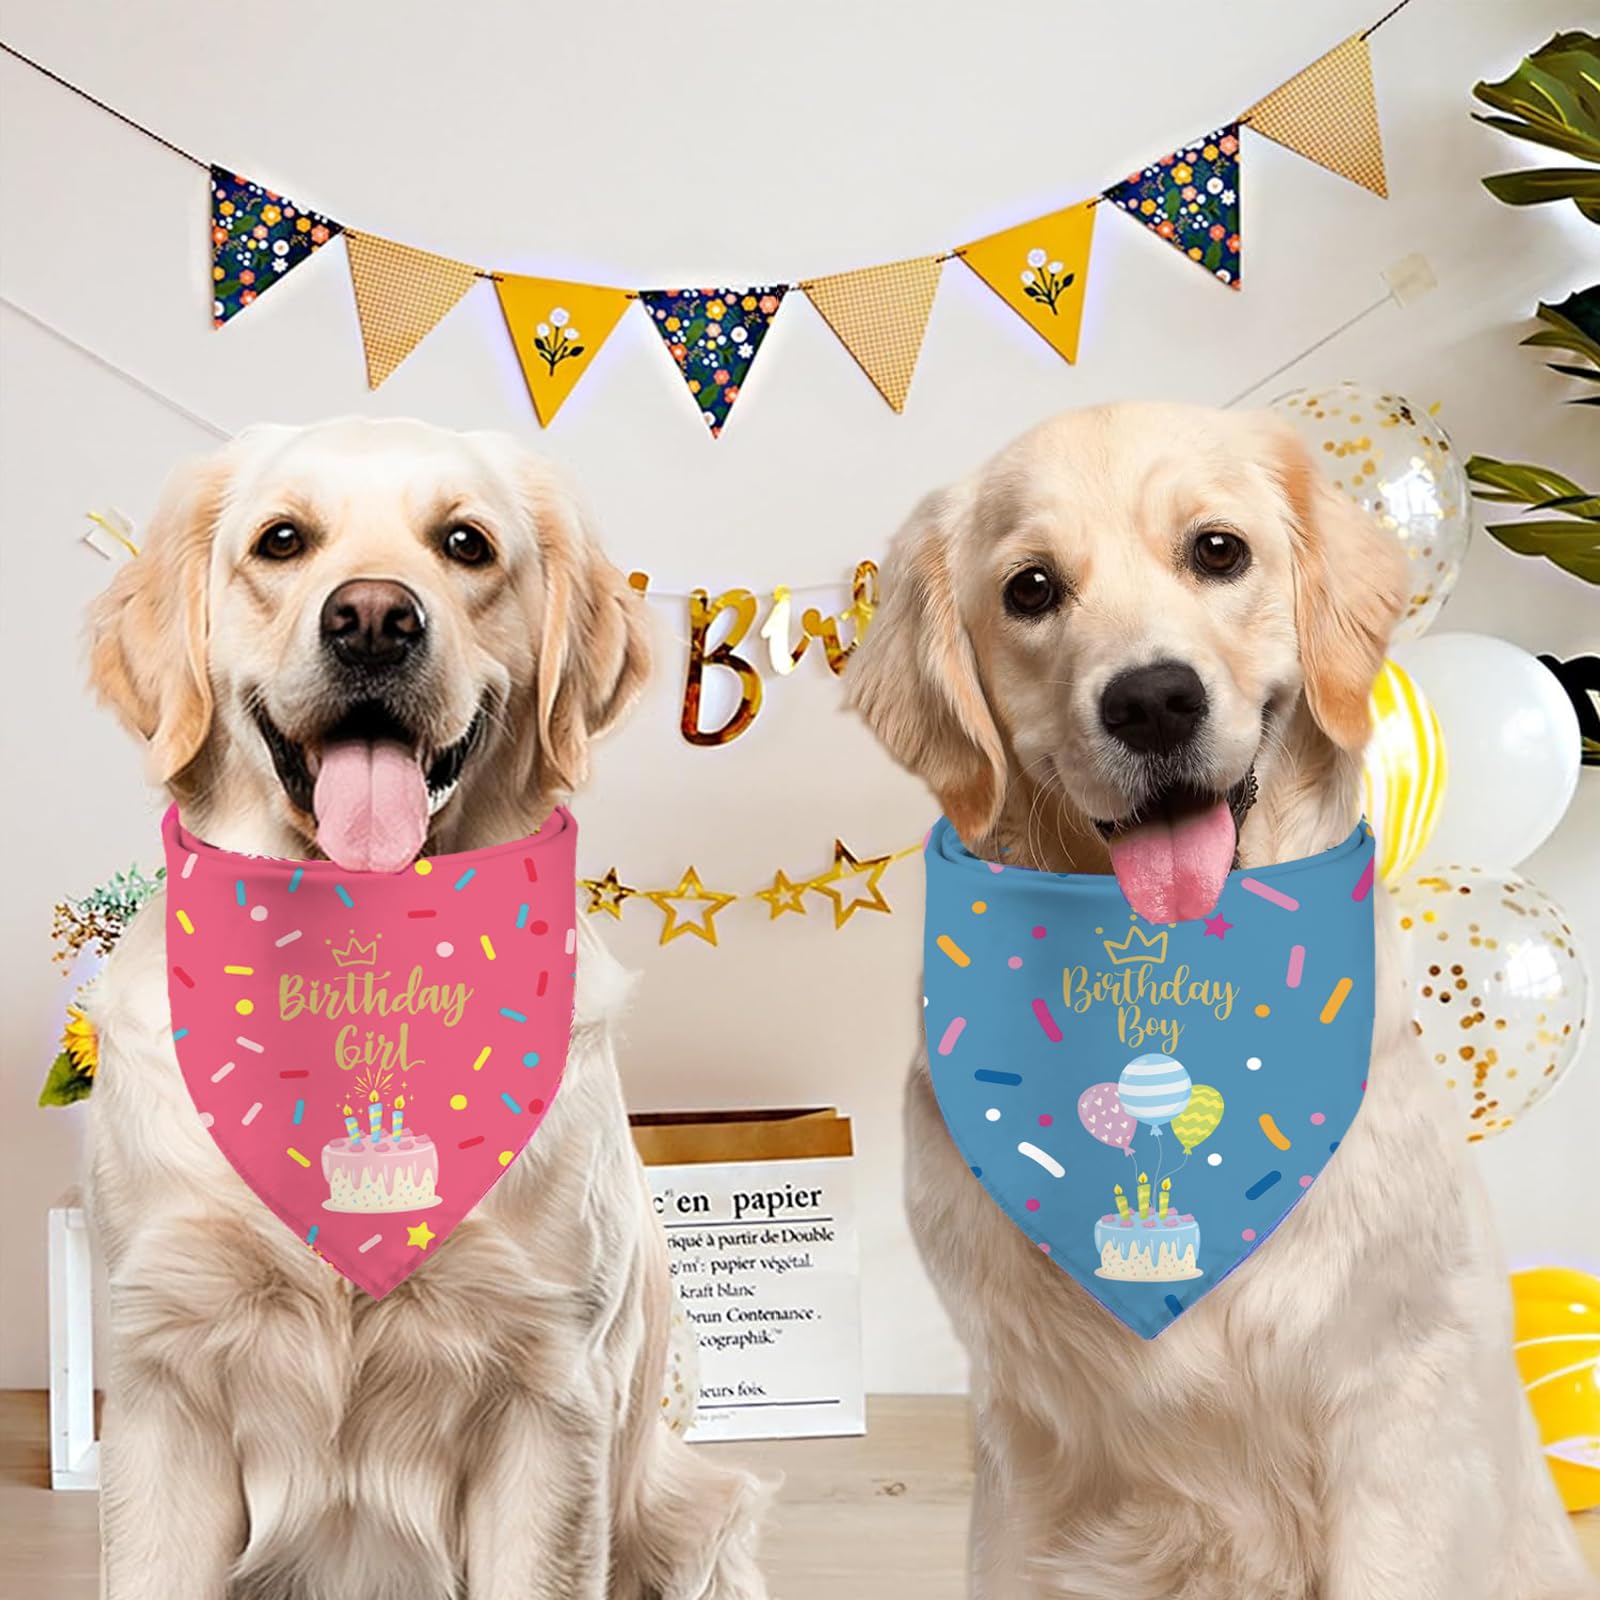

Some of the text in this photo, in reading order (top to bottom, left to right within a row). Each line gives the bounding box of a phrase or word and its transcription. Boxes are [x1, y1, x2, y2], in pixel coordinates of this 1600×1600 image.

[279, 965, 474, 1028] Birthday
[1062, 963, 1241, 1021] Birthday
[334, 1022, 426, 1072] Girl
[1117, 1004, 1186, 1055] Boy
[676, 1194, 711, 1214] en
[732, 1184, 822, 1219] papier
[718, 1230, 757, 1250] partir
[760, 1229, 779, 1244] de
[781, 1226, 835, 1244] Double
[710, 1257, 756, 1276] papier
[680, 1282, 757, 1299] kraft blanc
